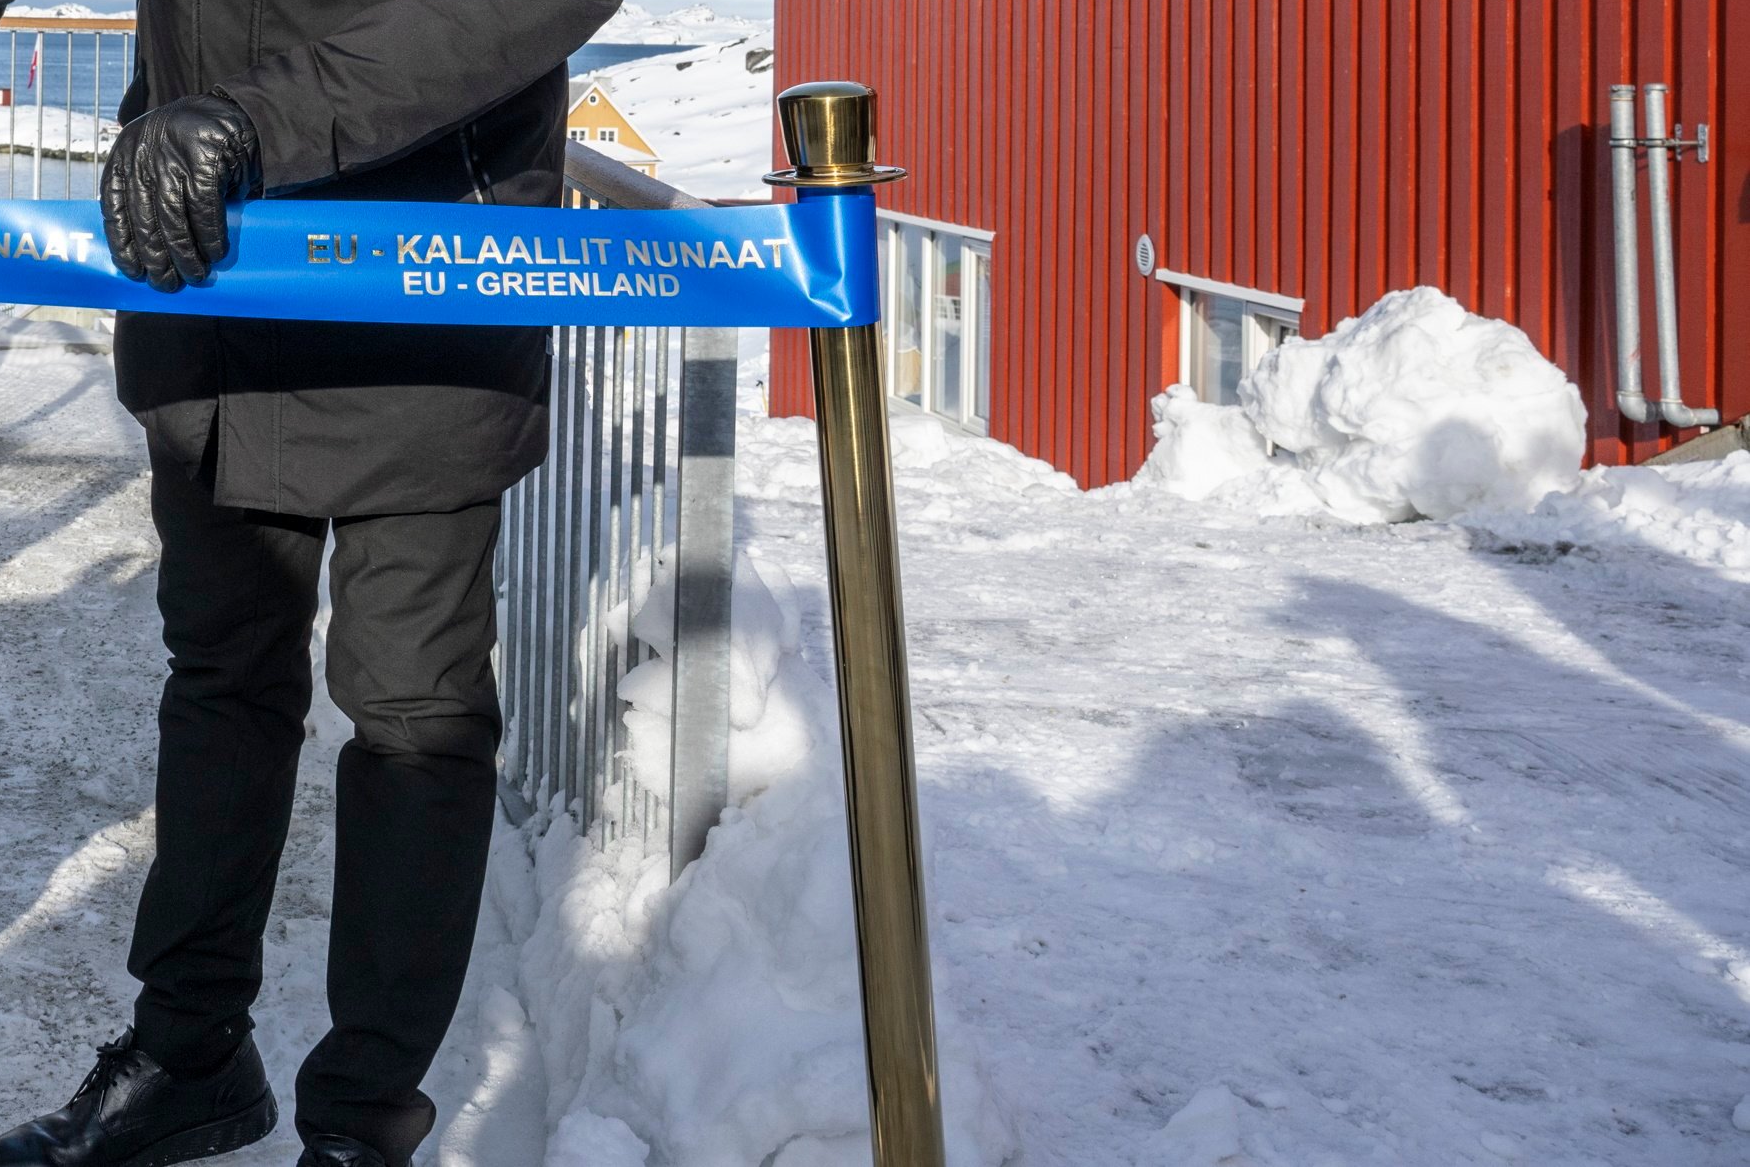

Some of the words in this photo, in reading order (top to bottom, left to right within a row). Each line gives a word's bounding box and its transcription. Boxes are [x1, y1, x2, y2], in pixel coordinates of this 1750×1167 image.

[307, 233, 358, 264] EU
[397, 234, 612, 265] KALAALLIT
[624, 238, 790, 269] NUNAAT
[403, 271, 447, 296] EU
[476, 271, 681, 297] GREENLAND
